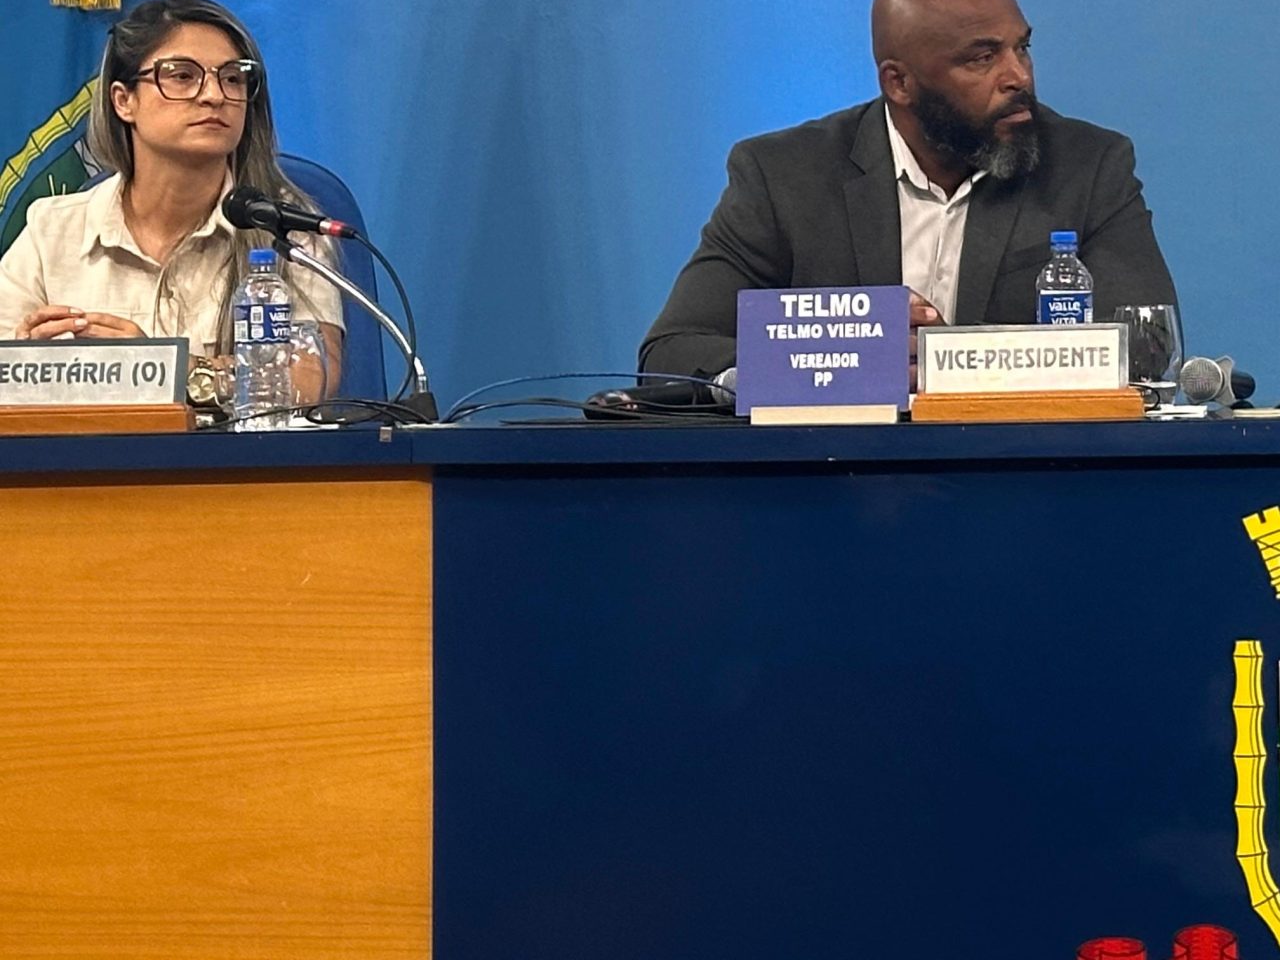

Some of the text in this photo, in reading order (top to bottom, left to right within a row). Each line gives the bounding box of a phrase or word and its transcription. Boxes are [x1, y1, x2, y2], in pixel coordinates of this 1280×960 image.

[780, 292, 870, 318] TELMO
[766, 323, 884, 340] TELMO VIEIRA
[790, 353, 860, 369] VEREADOR
[934, 346, 1111, 371] VICE-PRESIDENTE
[132, 361, 166, 387] (O)
[814, 372, 833, 387] PP
